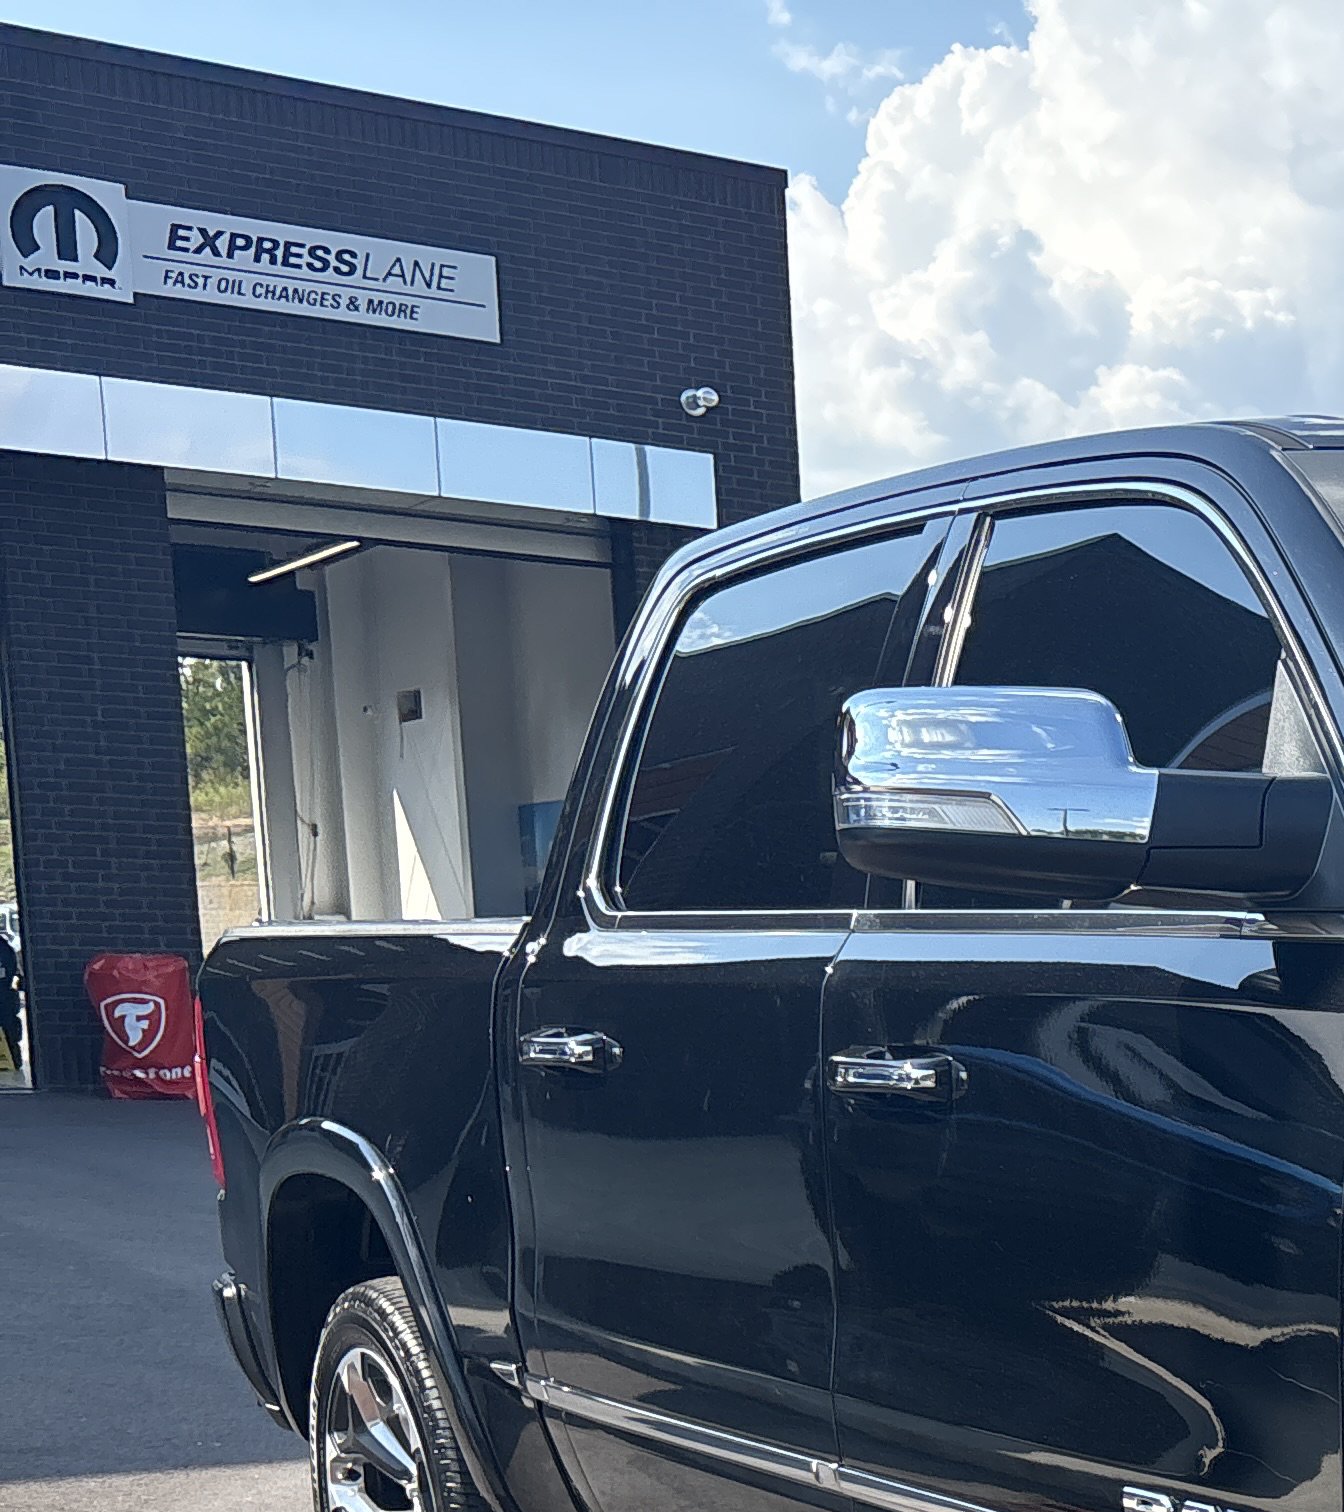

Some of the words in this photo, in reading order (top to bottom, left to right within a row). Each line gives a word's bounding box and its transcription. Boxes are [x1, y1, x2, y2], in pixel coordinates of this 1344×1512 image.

[19, 265, 119, 289] MOPAR
[163, 268, 211, 292] FAST
[216, 277, 247, 297] OIL
[251, 282, 341, 311] CHANGES
[345, 296, 361, 312] &
[365, 299, 420, 321] MORE
